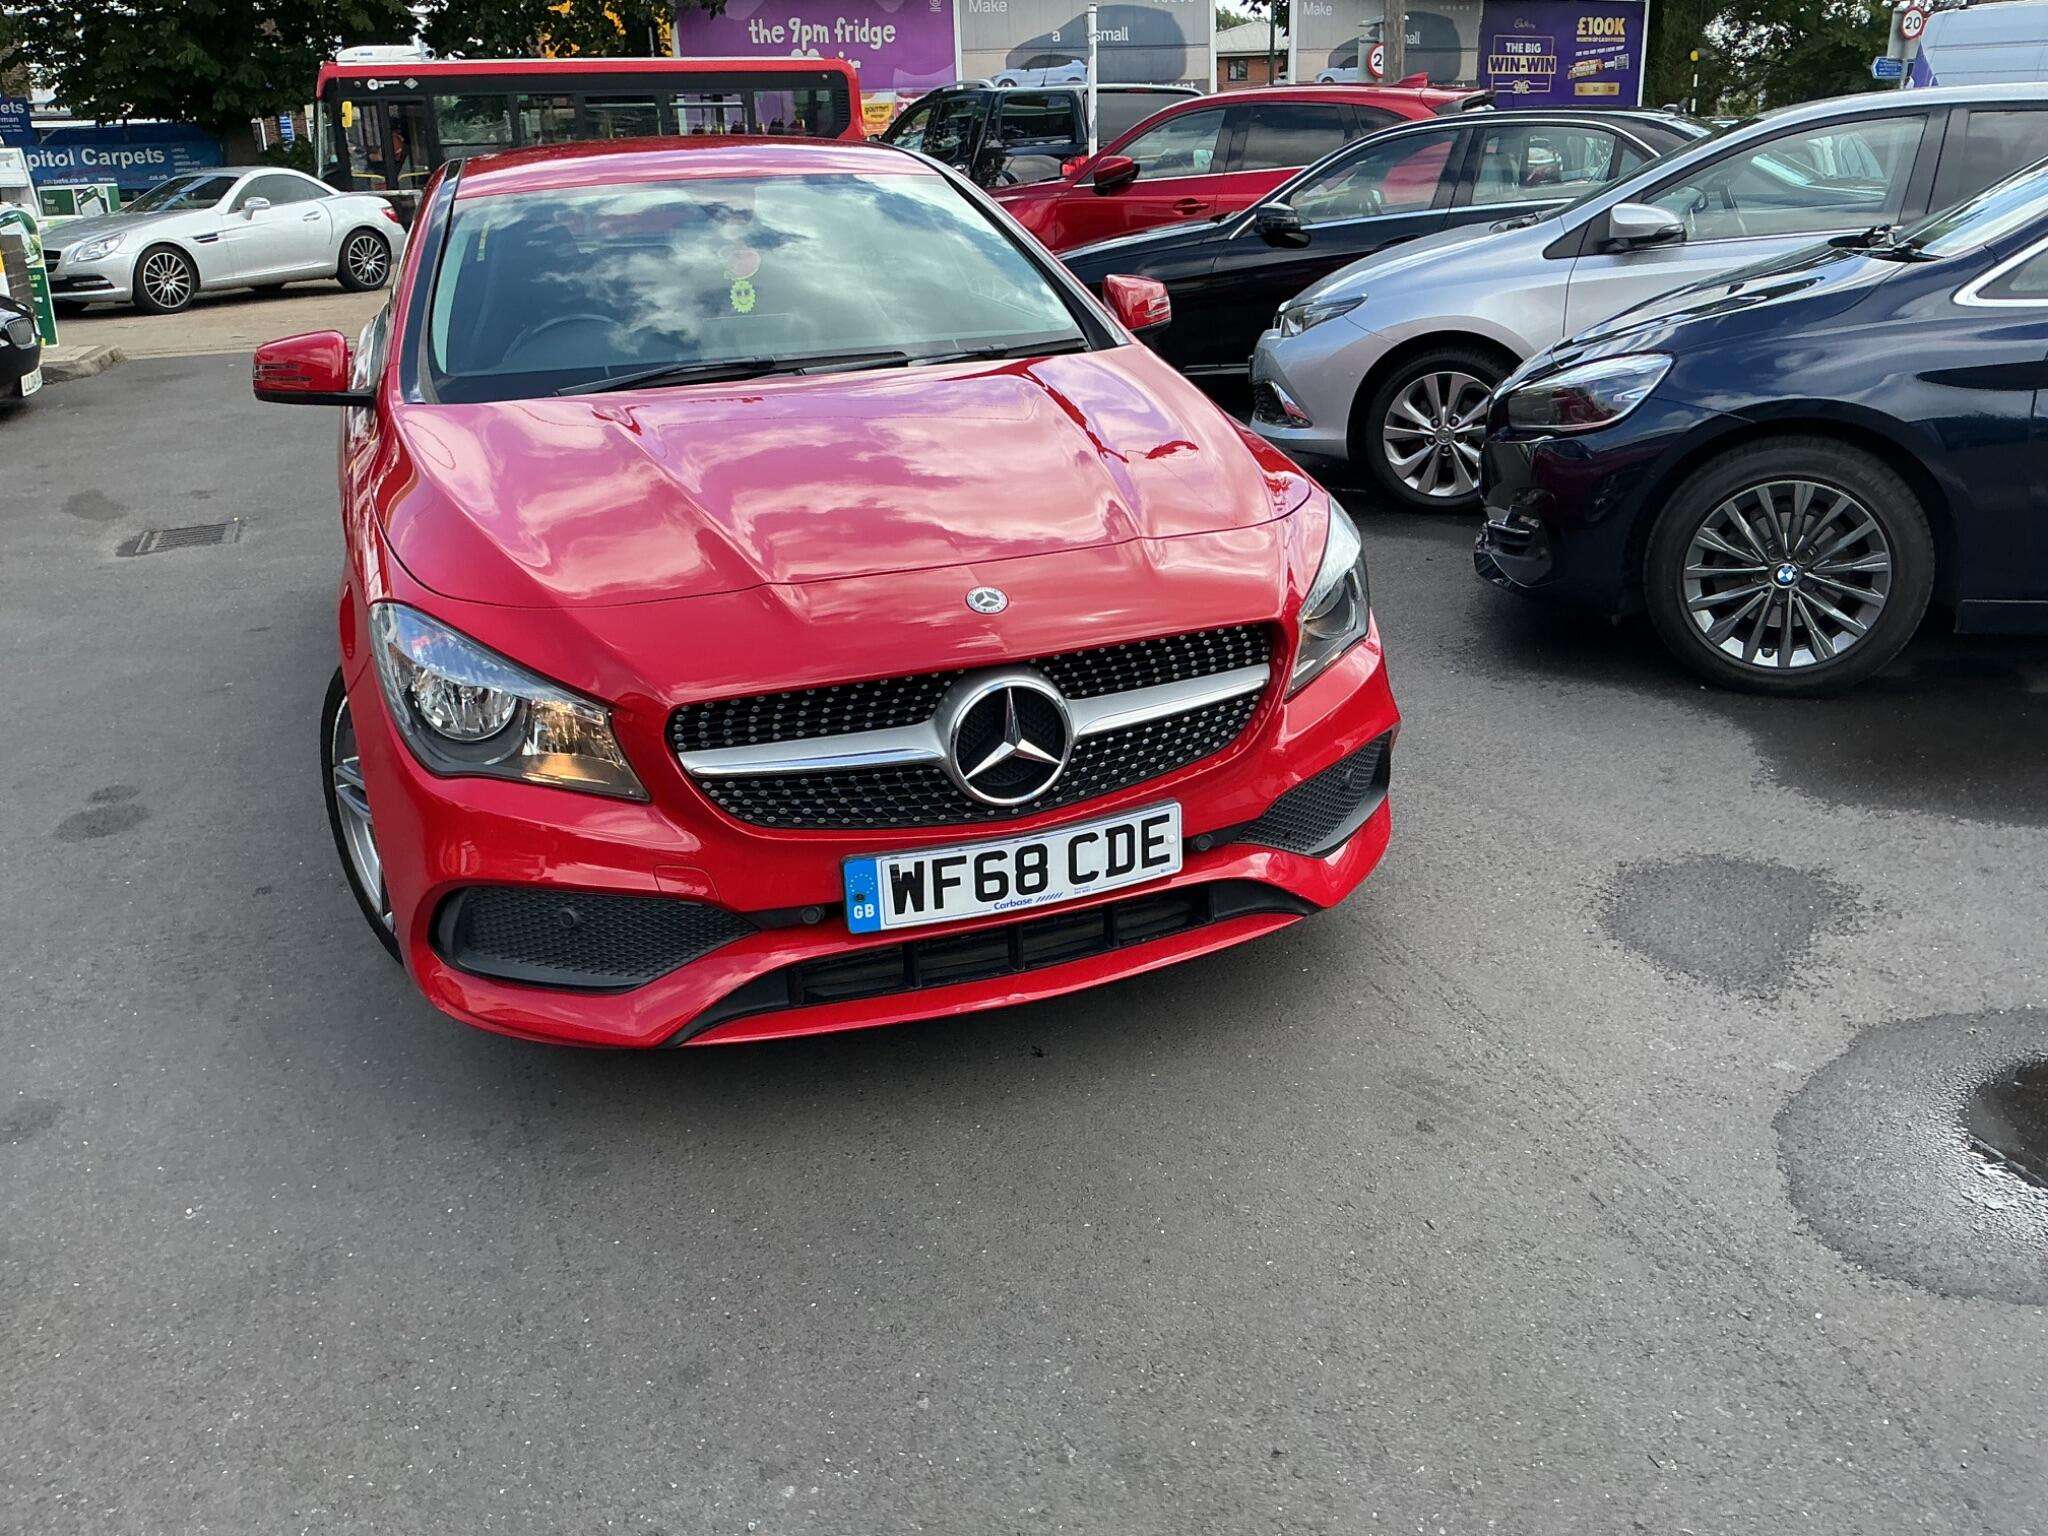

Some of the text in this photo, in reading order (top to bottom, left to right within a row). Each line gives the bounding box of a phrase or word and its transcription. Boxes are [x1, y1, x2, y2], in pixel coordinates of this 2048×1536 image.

[968, 0, 1008, 13] Make
[1303, 3, 1333, 16] Make
[1576, 17, 1626, 35] £100K
[1905, 17, 1921, 29] 20
[748, 17, 896, 51] the 9pm fridge
[1052, 31, 1061, 42] a
[1505, 42, 1541, 53] THE BIG
[1374, 53, 1383, 66] 2
[1489, 56, 1555, 72] WIN-WIN
[0, 102, 25, 114] ets
[27, 147, 165, 171] pitol Carpets
[888, 813, 1170, 915] WF68 CDE
[994, 896, 1033, 911] Carbase
[853, 905, 875, 919] GB
